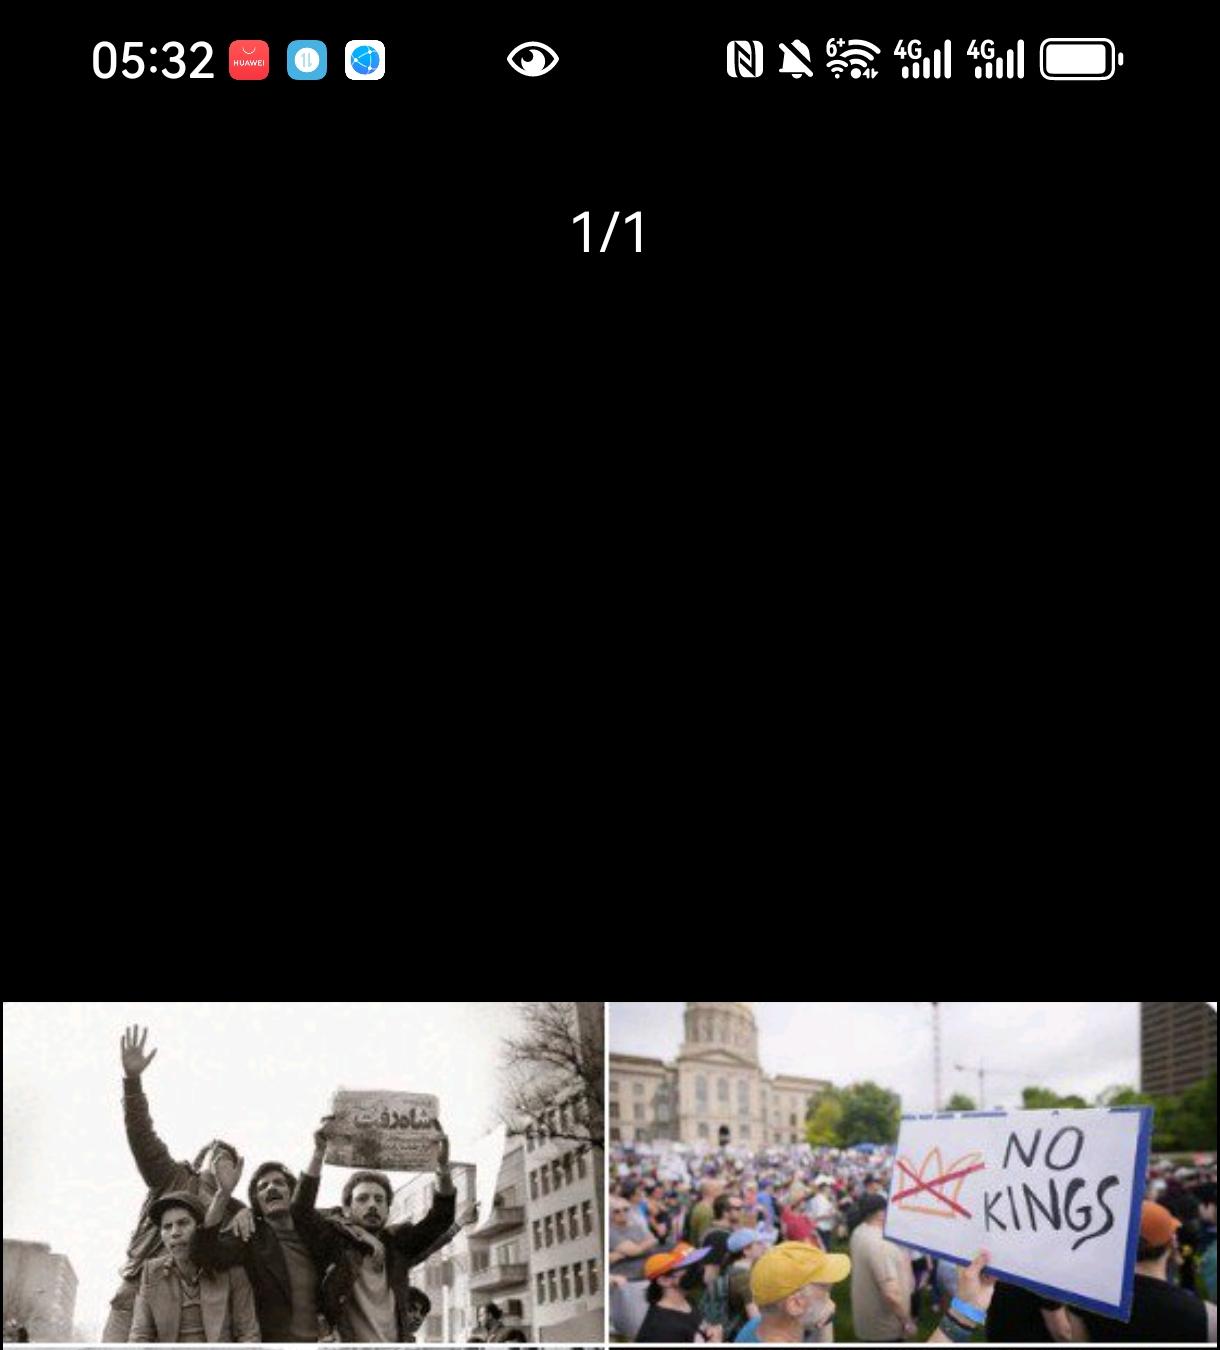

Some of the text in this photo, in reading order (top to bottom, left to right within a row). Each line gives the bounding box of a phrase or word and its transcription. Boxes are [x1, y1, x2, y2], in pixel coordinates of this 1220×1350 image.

[93, 41, 214, 79] 05:32
[894, 40, 922, 59] 4G
[967, 40, 995, 59] 4G
[572, 211, 642, 253] 1/1
[1003, 1126, 1085, 1171] NO
[984, 1175, 1119, 1250] KINGS
